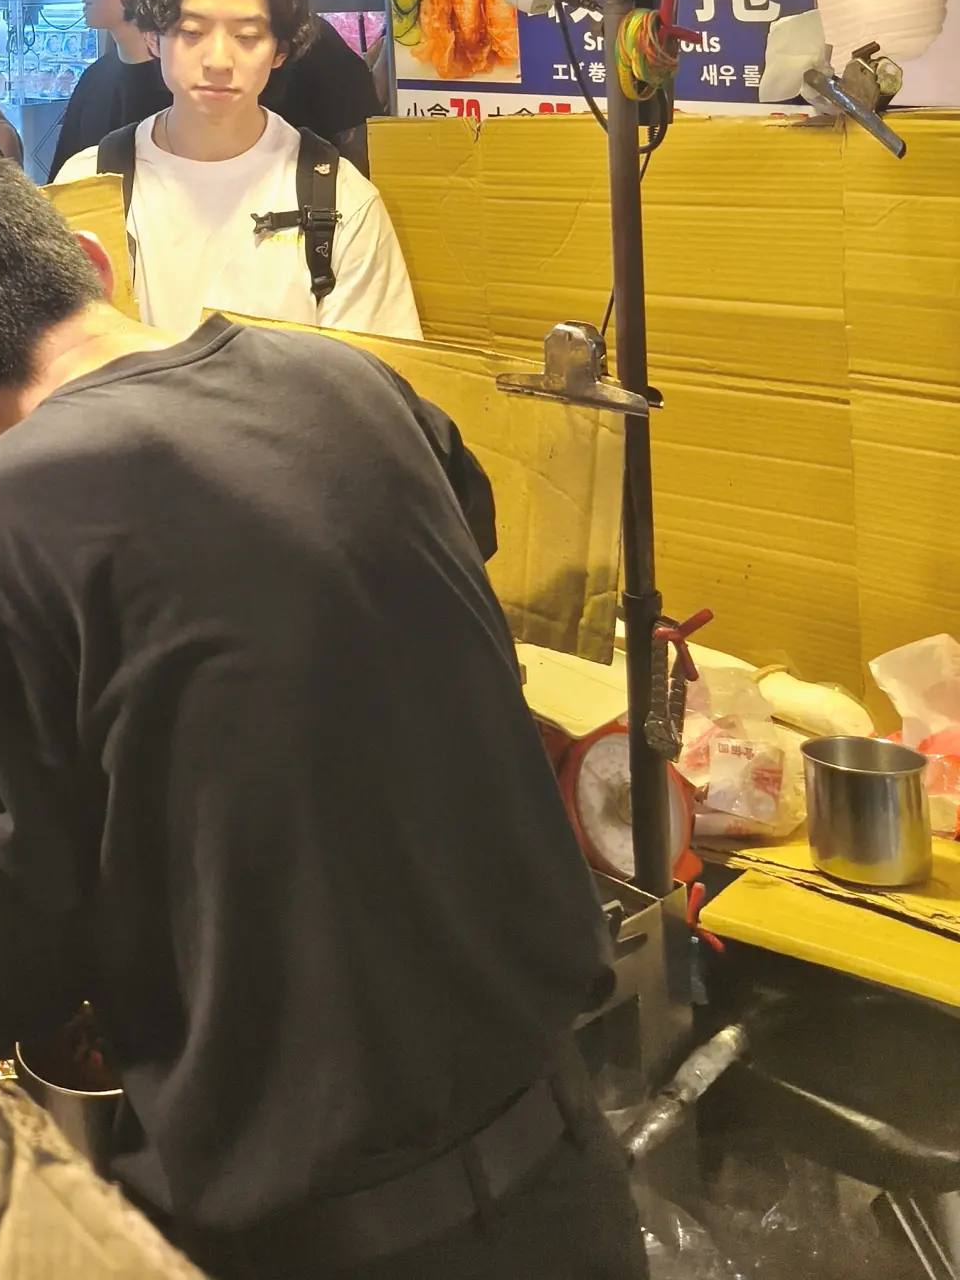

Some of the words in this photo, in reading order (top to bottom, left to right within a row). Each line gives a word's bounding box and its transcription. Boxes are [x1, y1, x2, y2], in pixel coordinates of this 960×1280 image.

[678, 34, 721, 54] olls
[700, 64, 737, 88] 새우
[742, 64, 761, 89] 롤
